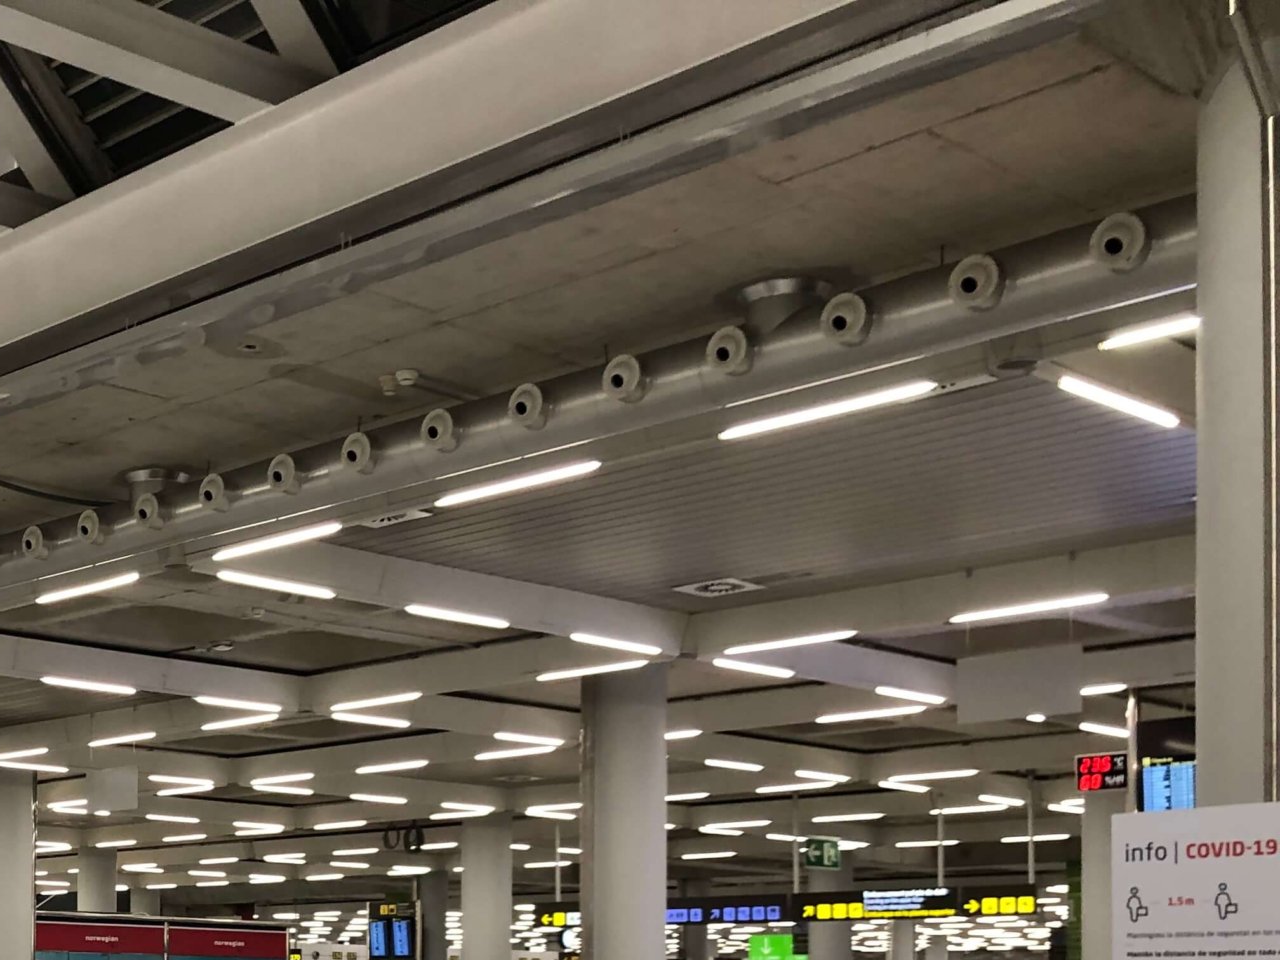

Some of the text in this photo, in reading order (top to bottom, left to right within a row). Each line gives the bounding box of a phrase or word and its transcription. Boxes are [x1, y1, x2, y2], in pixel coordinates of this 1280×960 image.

[1125, 839, 1278, 862] info COVID-19
[85, 935, 119, 944] norwegian
[214, 939, 245, 948] norwegian
